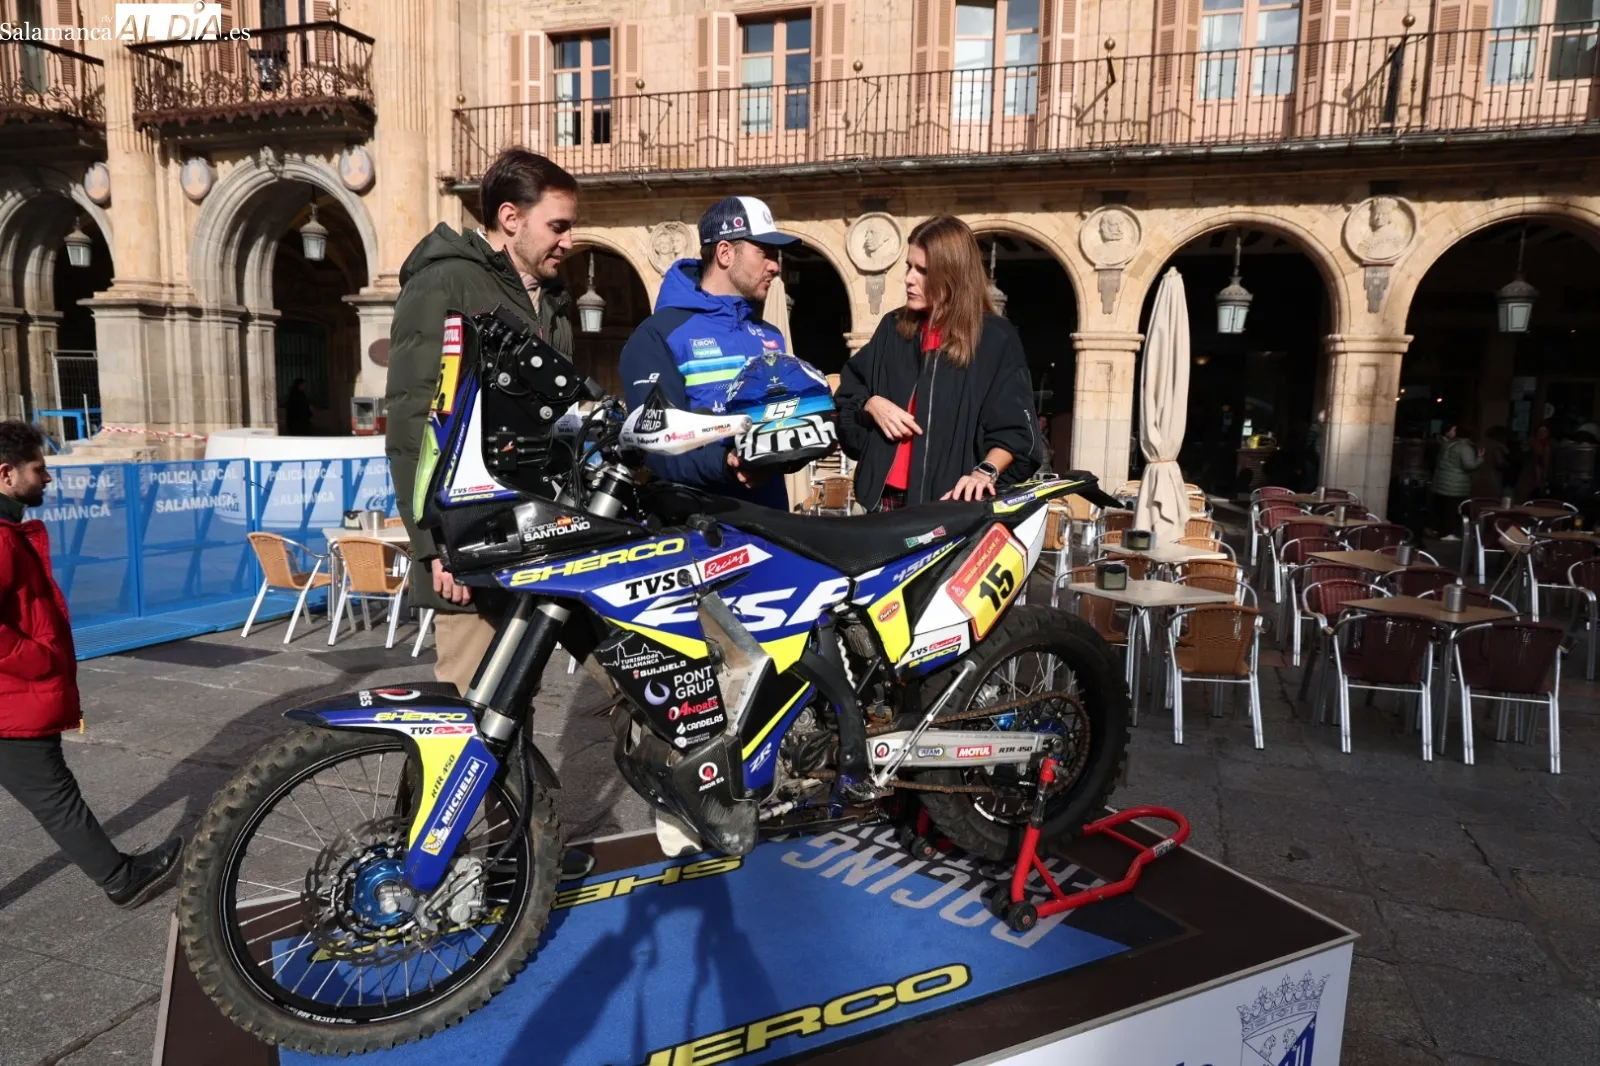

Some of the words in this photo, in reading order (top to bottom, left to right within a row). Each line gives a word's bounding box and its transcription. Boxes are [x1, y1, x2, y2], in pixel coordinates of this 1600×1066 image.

[443, 328, 460, 343] OTUL
[645, 408, 664, 420] PONT
[641, 419, 662, 432] GRUP
[67, 473, 116, 490] LOCAL
[150, 471, 199, 487] POLICIA
[201, 467, 238, 482] LOCAL
[155, 494, 236, 514] SALAMANCA
[1006, 492, 1036, 505] MICHELIN
[23, 502, 112, 523] ALAMANCA
[523, 520, 591, 542] SANTOLINO
[509, 537, 685, 587] SHERCO
[625, 570, 677, 600] TVS
[705, 549, 748, 578] Racing
[979, 562, 1016, 612] 15
[909, 646, 928, 659] TVS
[621, 658, 659, 670] SALAMANCA
[674, 665, 712, 688] PONT
[675, 678, 714, 699] GRUP
[410, 726, 432, 735] TVS
[686, 714, 724, 731] CANDELAS
[958, 747, 990, 757] MOTUL
[443, 753, 456, 776] 450
[441, 760, 480, 825] MICHELIN
